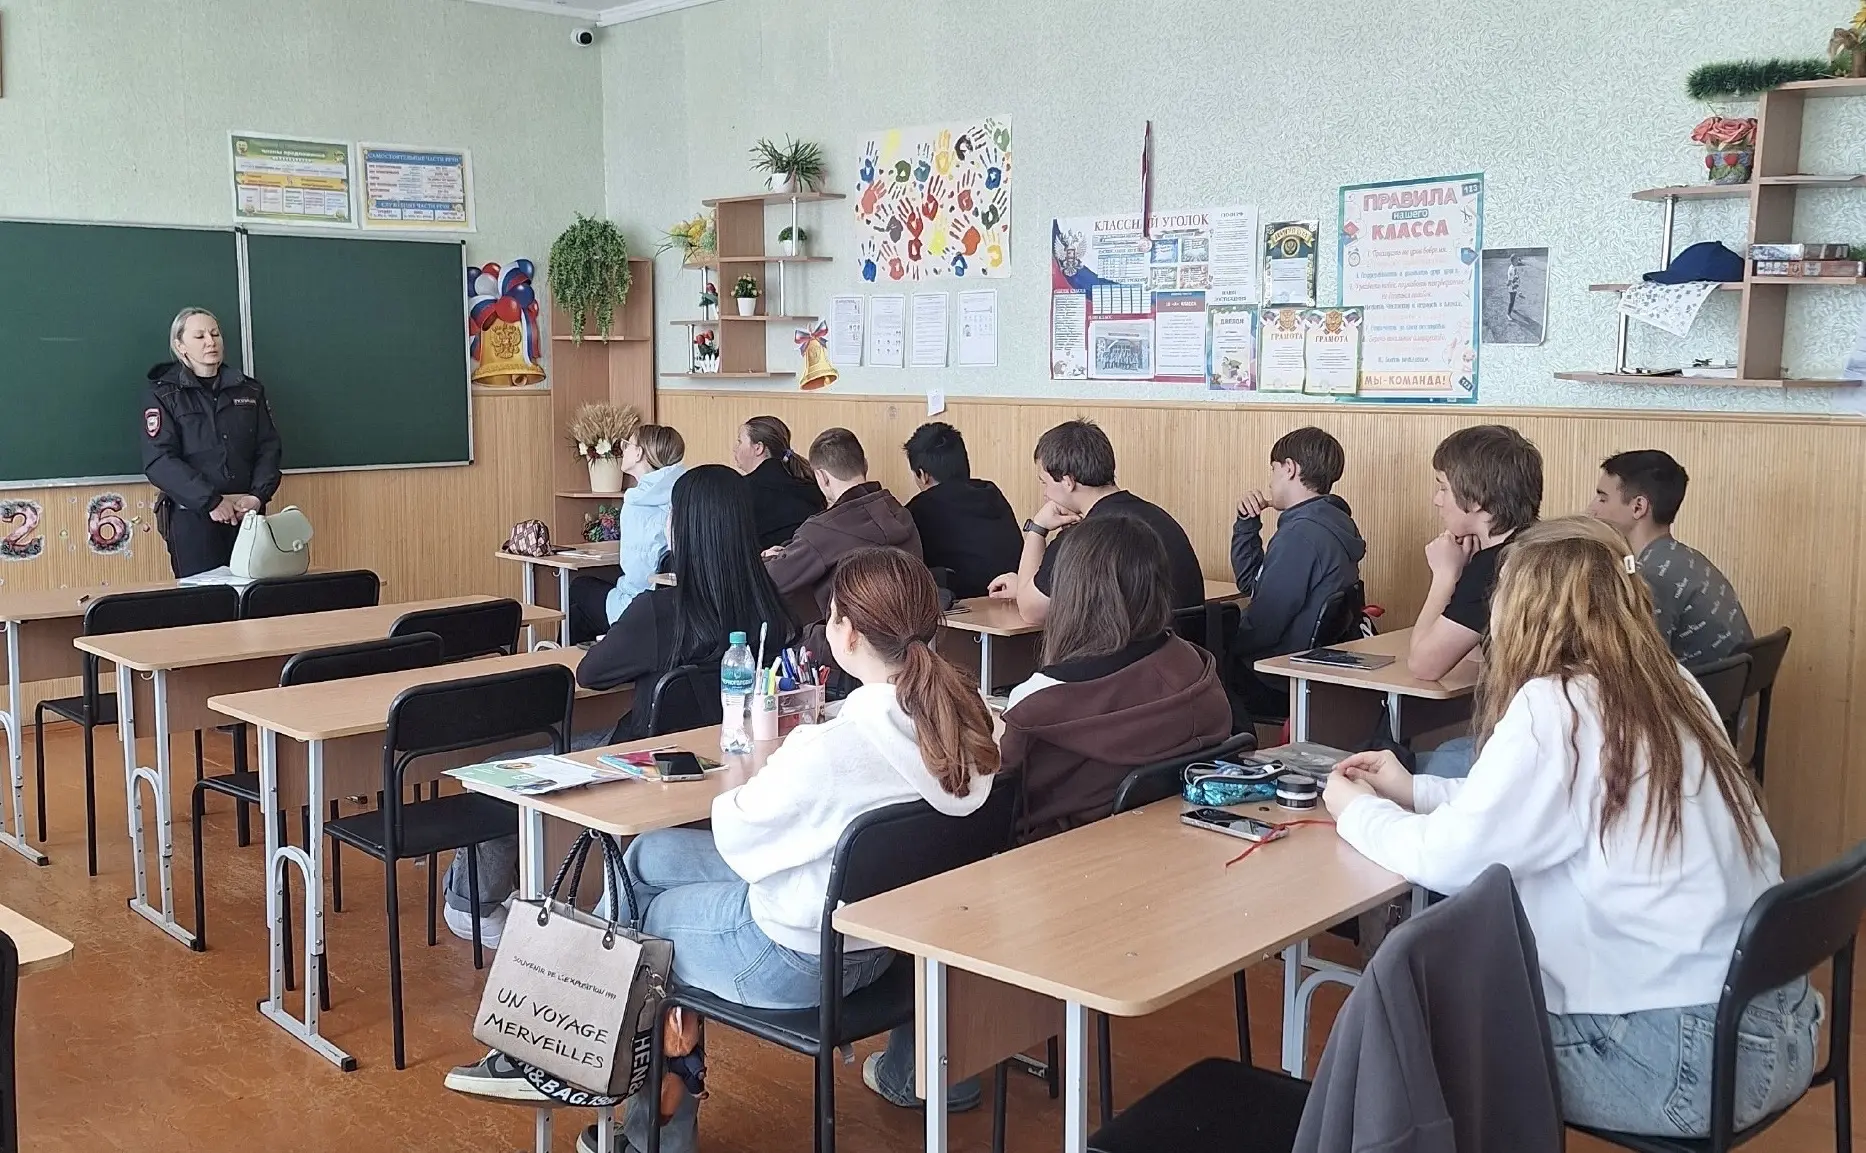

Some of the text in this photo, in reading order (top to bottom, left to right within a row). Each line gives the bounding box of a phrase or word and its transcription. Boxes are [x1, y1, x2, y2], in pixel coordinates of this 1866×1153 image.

[1363, 187, 1458, 212] ПРАВИЛА
[1094, 213, 1210, 232] КЛАССНЙ УГОЛОК
[1393, 209, 1428, 220] нашего
[1371, 219, 1449, 241] КЛАССА
[1270, 332, 1304, 341] ГРАМОТА
[1315, 335, 1349, 343] ГРАМОТА
[1, 496, 129, 552] 2 6
[512, 955, 546, 974] SOUVENIR
[547, 970, 556, 978] DE
[497, 987, 610, 1045] UN VOYAGE
